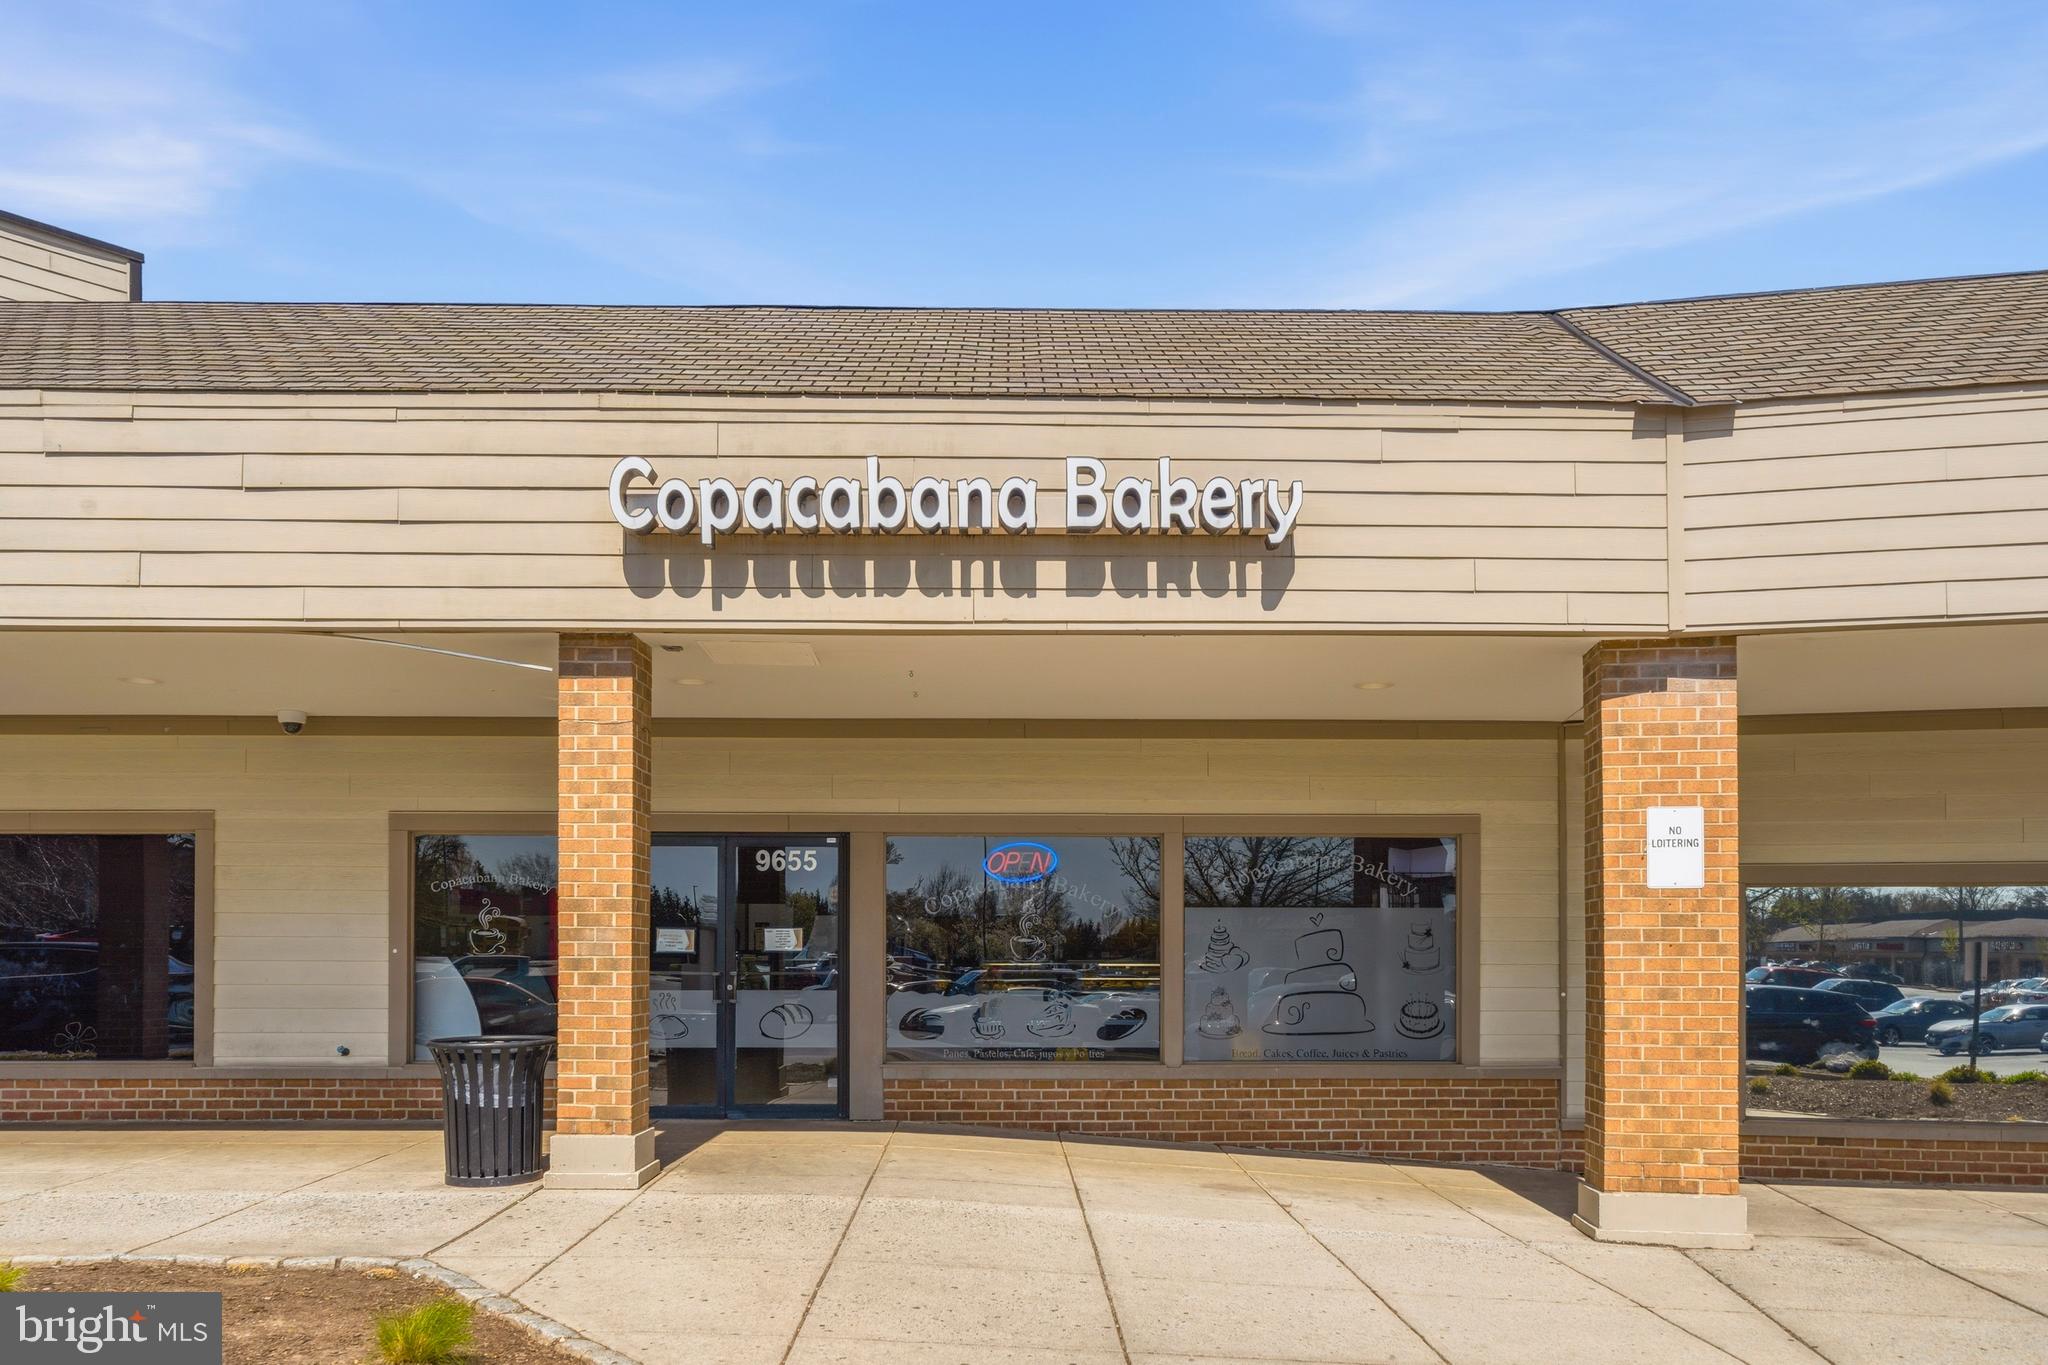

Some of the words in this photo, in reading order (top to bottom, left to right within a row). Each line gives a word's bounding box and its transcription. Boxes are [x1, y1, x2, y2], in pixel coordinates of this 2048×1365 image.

[609, 454, 1038, 548] Copacabana
[1066, 456, 1304, 549] Bakery
[1668, 826, 1682, 835] NO
[1651, 838, 1700, 848] LOITERING
[755, 849, 818, 872] 9655
[987, 851, 1051, 874] OPEN
[509, 873, 553, 896] Bakery
[1352, 855, 1418, 897] Bakery
[1361, 1048, 1371, 1059] &
[1373, 1048, 1408, 1059] Pastries
